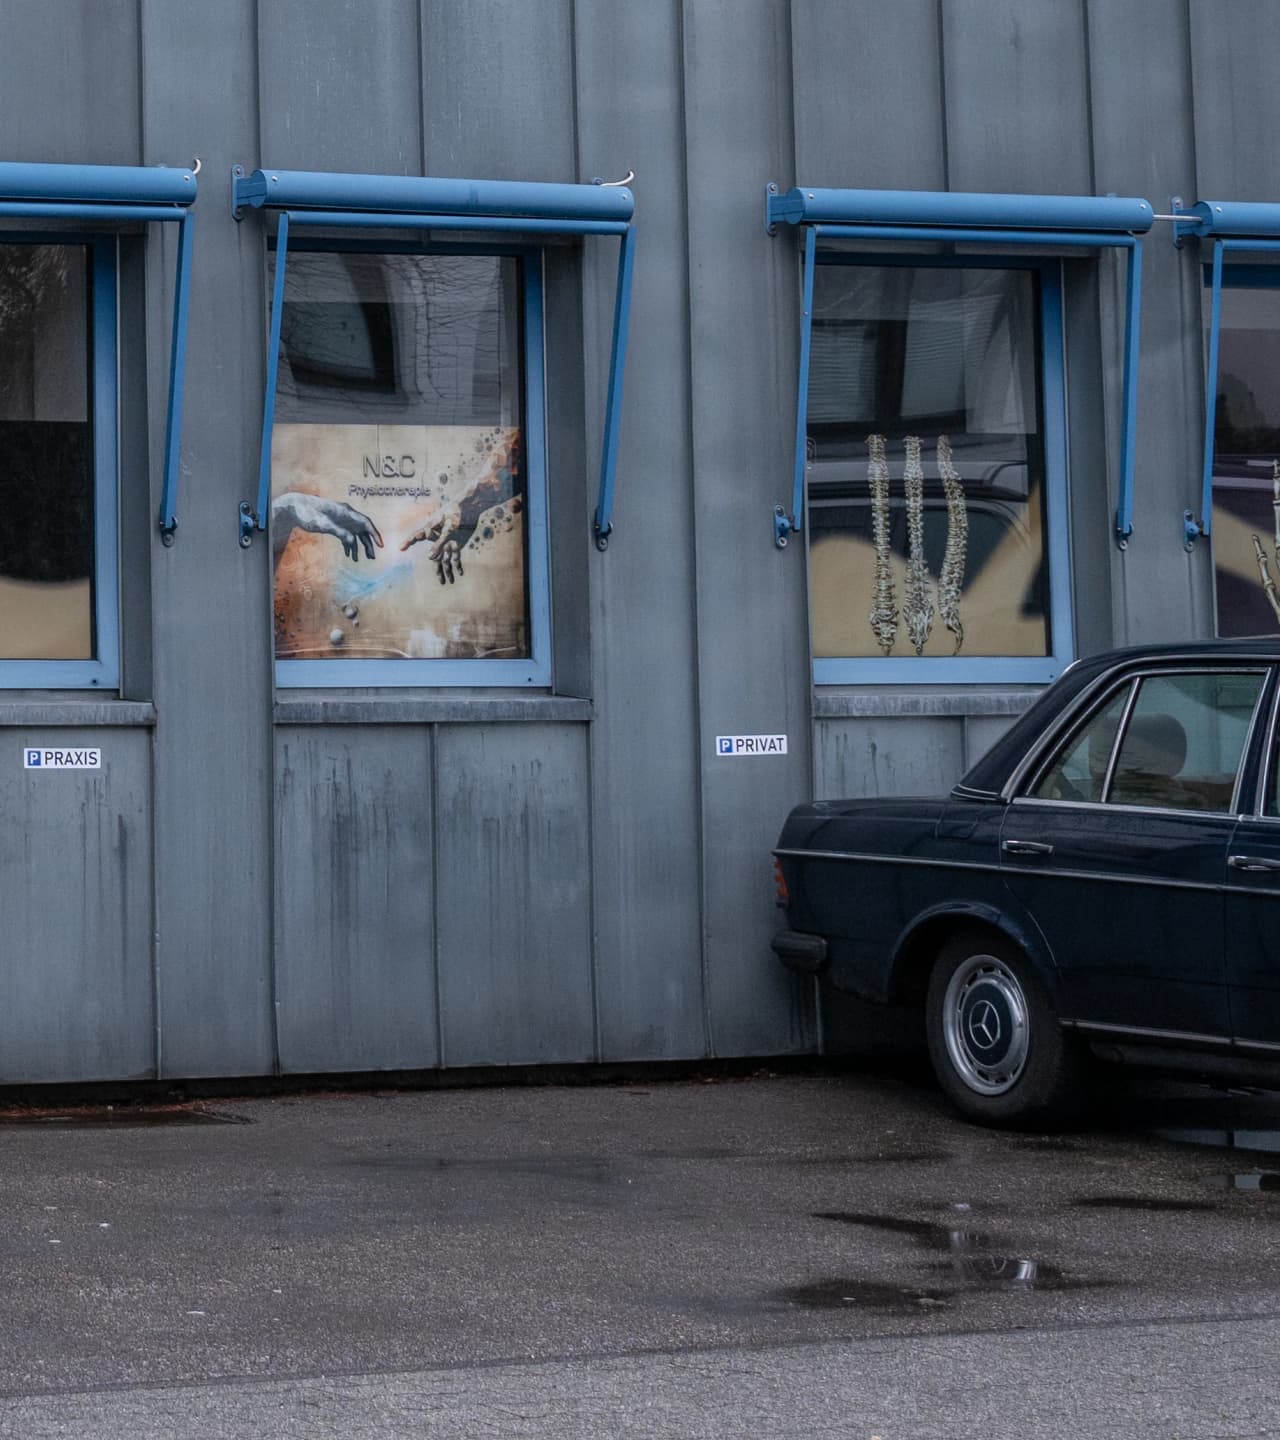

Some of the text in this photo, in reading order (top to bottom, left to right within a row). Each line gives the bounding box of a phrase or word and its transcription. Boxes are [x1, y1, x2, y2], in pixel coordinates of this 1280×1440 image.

[362, 455, 416, 478] N&C
[348, 484, 432, 501] Physiotherapie
[736, 737, 784, 752] PRIVAT
[44, 751, 98, 766] PRAXIS
